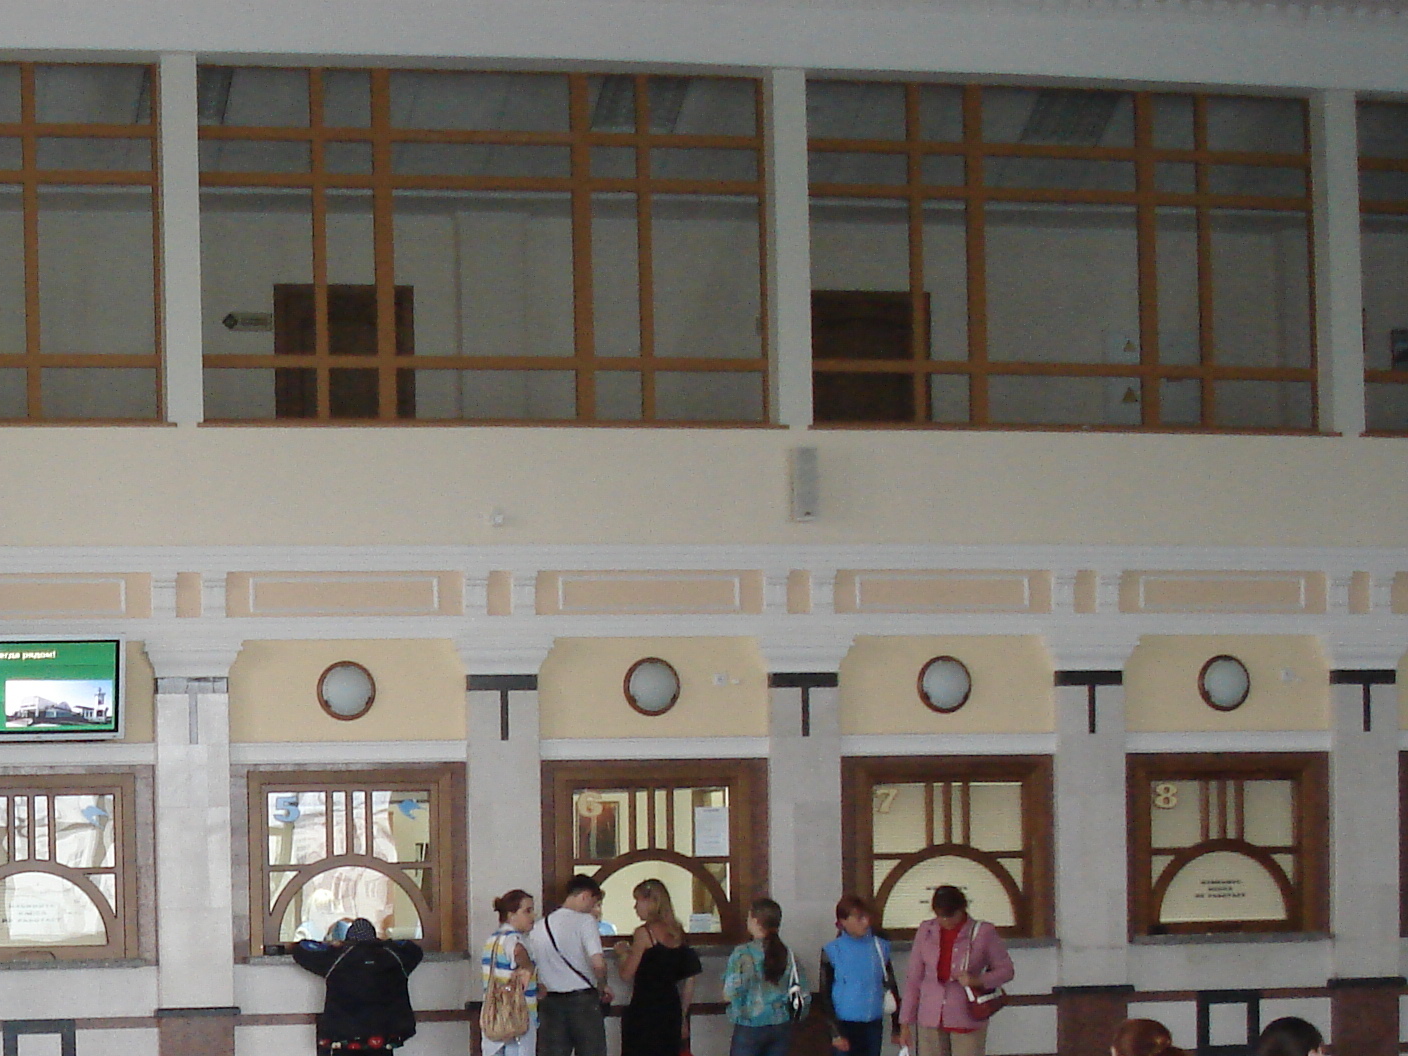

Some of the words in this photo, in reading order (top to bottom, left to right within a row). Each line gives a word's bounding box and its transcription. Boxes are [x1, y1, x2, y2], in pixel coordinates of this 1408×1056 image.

[22, 650, 56, 661] рядом!
[577, 791, 603, 817] 6
[875, 788, 897, 814] 7
[1154, 783, 1178, 809] 8
[273, 796, 300, 823] 5
